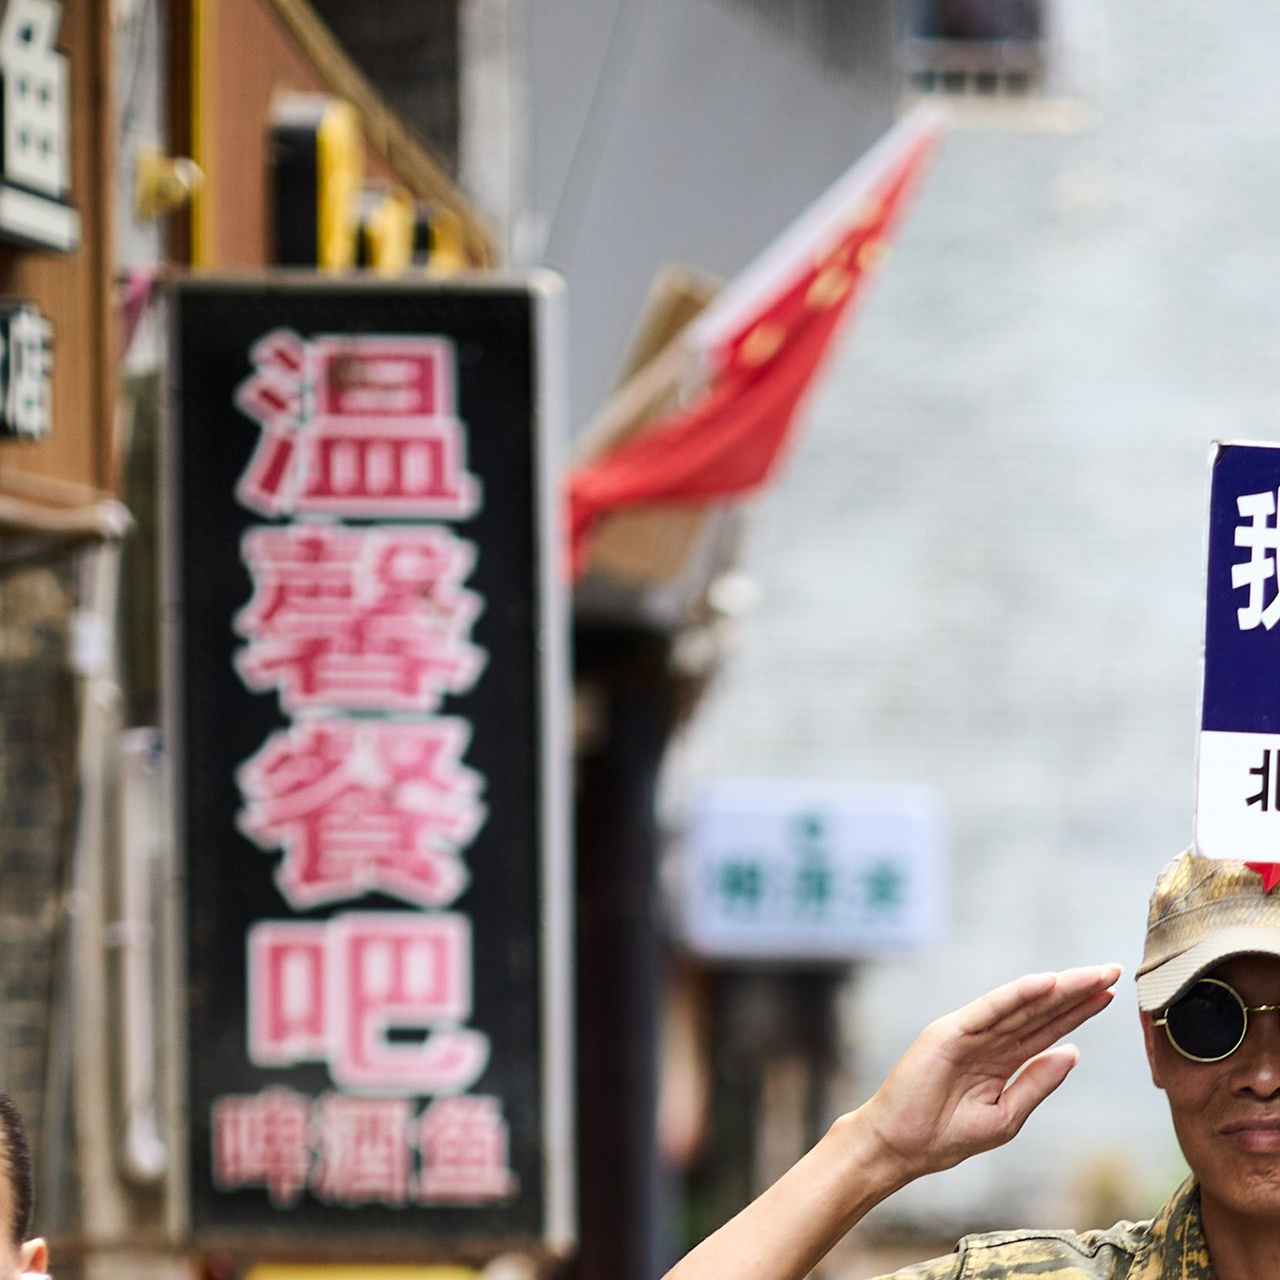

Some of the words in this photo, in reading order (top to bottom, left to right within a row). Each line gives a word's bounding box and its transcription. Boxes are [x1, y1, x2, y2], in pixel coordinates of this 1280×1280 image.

[233, 328, 490, 1094] 温馨餐吧
[211, 1087, 513, 1207] 啤酒鱼
